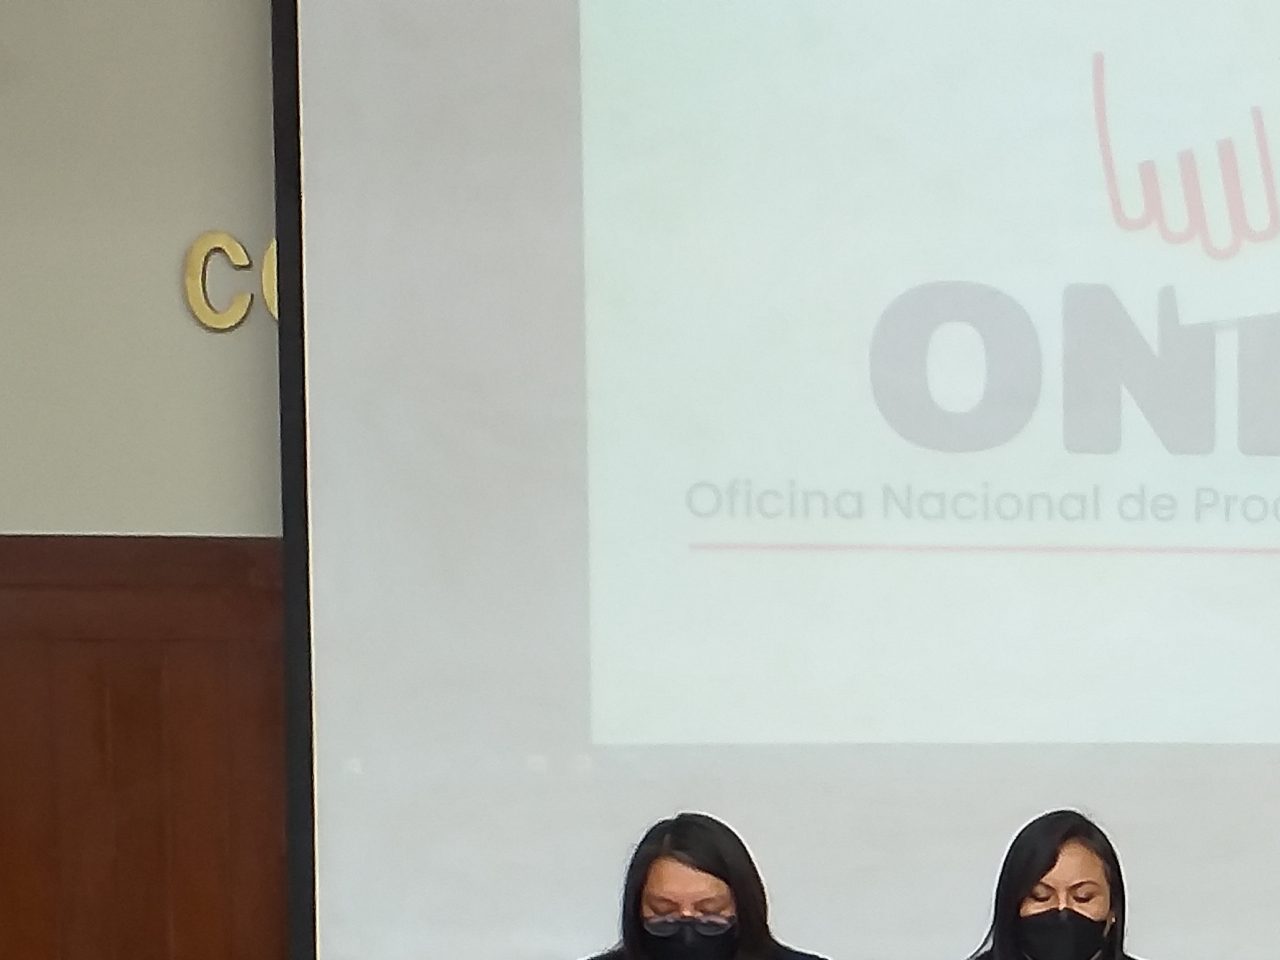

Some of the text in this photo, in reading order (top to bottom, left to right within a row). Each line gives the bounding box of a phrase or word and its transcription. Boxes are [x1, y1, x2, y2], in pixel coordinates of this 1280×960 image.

[185, 229, 279, 333] C
[686, 479, 864, 520] Oficina
[882, 482, 1101, 523] Nacional
[1118, 485, 1178, 522] de
